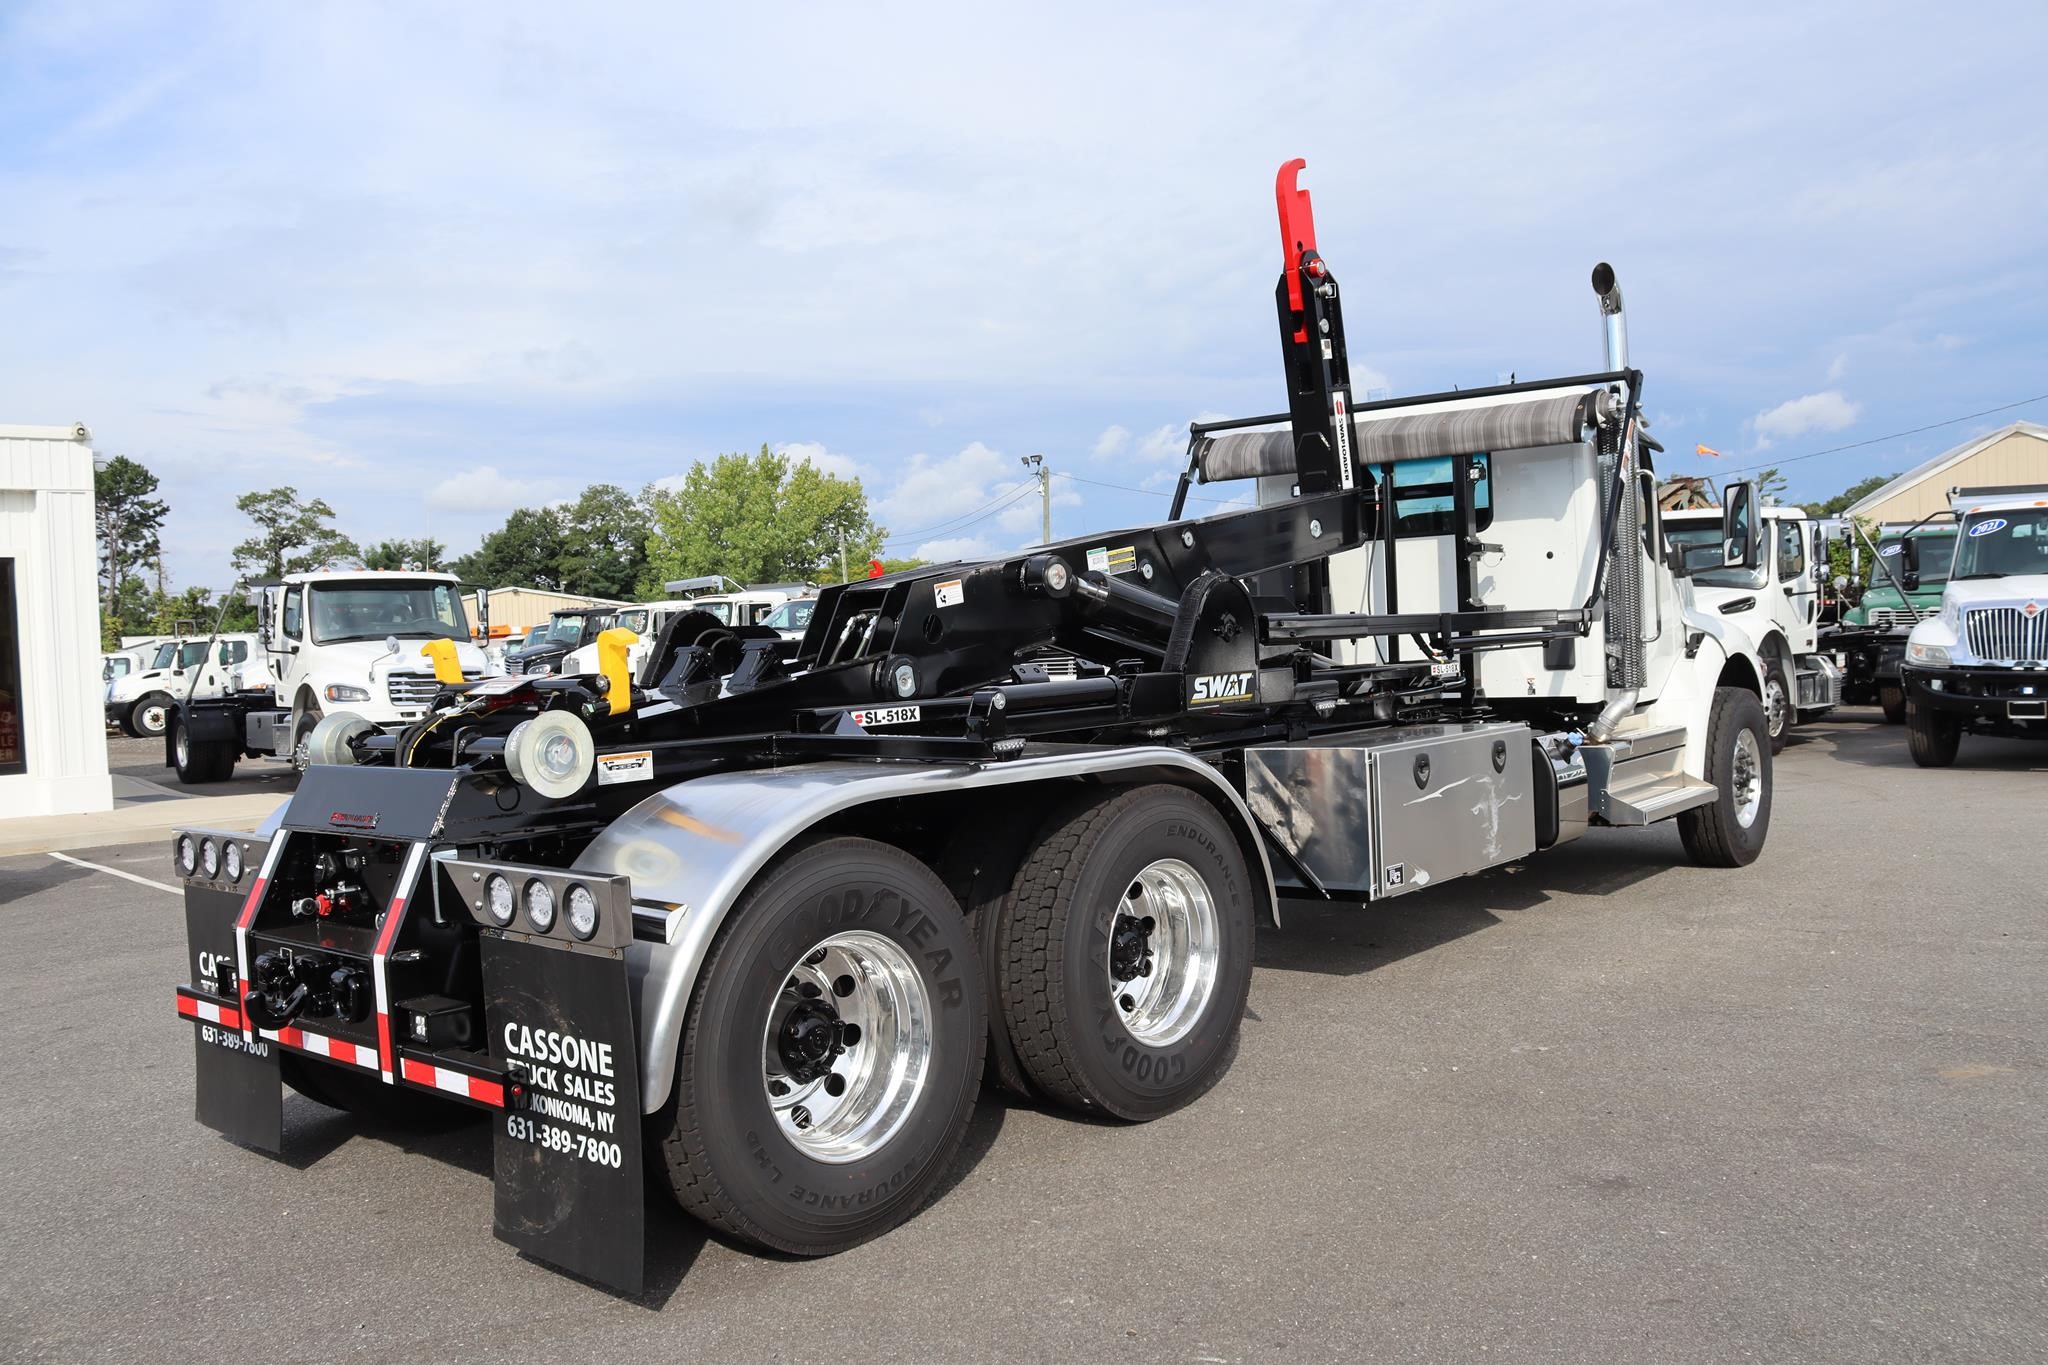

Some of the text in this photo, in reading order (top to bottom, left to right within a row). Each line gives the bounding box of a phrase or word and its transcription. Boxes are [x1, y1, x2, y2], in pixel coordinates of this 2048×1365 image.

[1339, 417, 1350, 481] SWAPLOADER
[1192, 673, 1252, 700] SWAT
[1166, 825, 1241, 907] ENDURANCE
[768, 887, 964, 1010] GOODYEAR
[504, 1022, 614, 1077] CASSONE
[507, 1058, 616, 1106] UCK SALES
[529, 1093, 615, 1133] KONKOMA, NY
[507, 1115, 622, 1168] 631-389-7800
